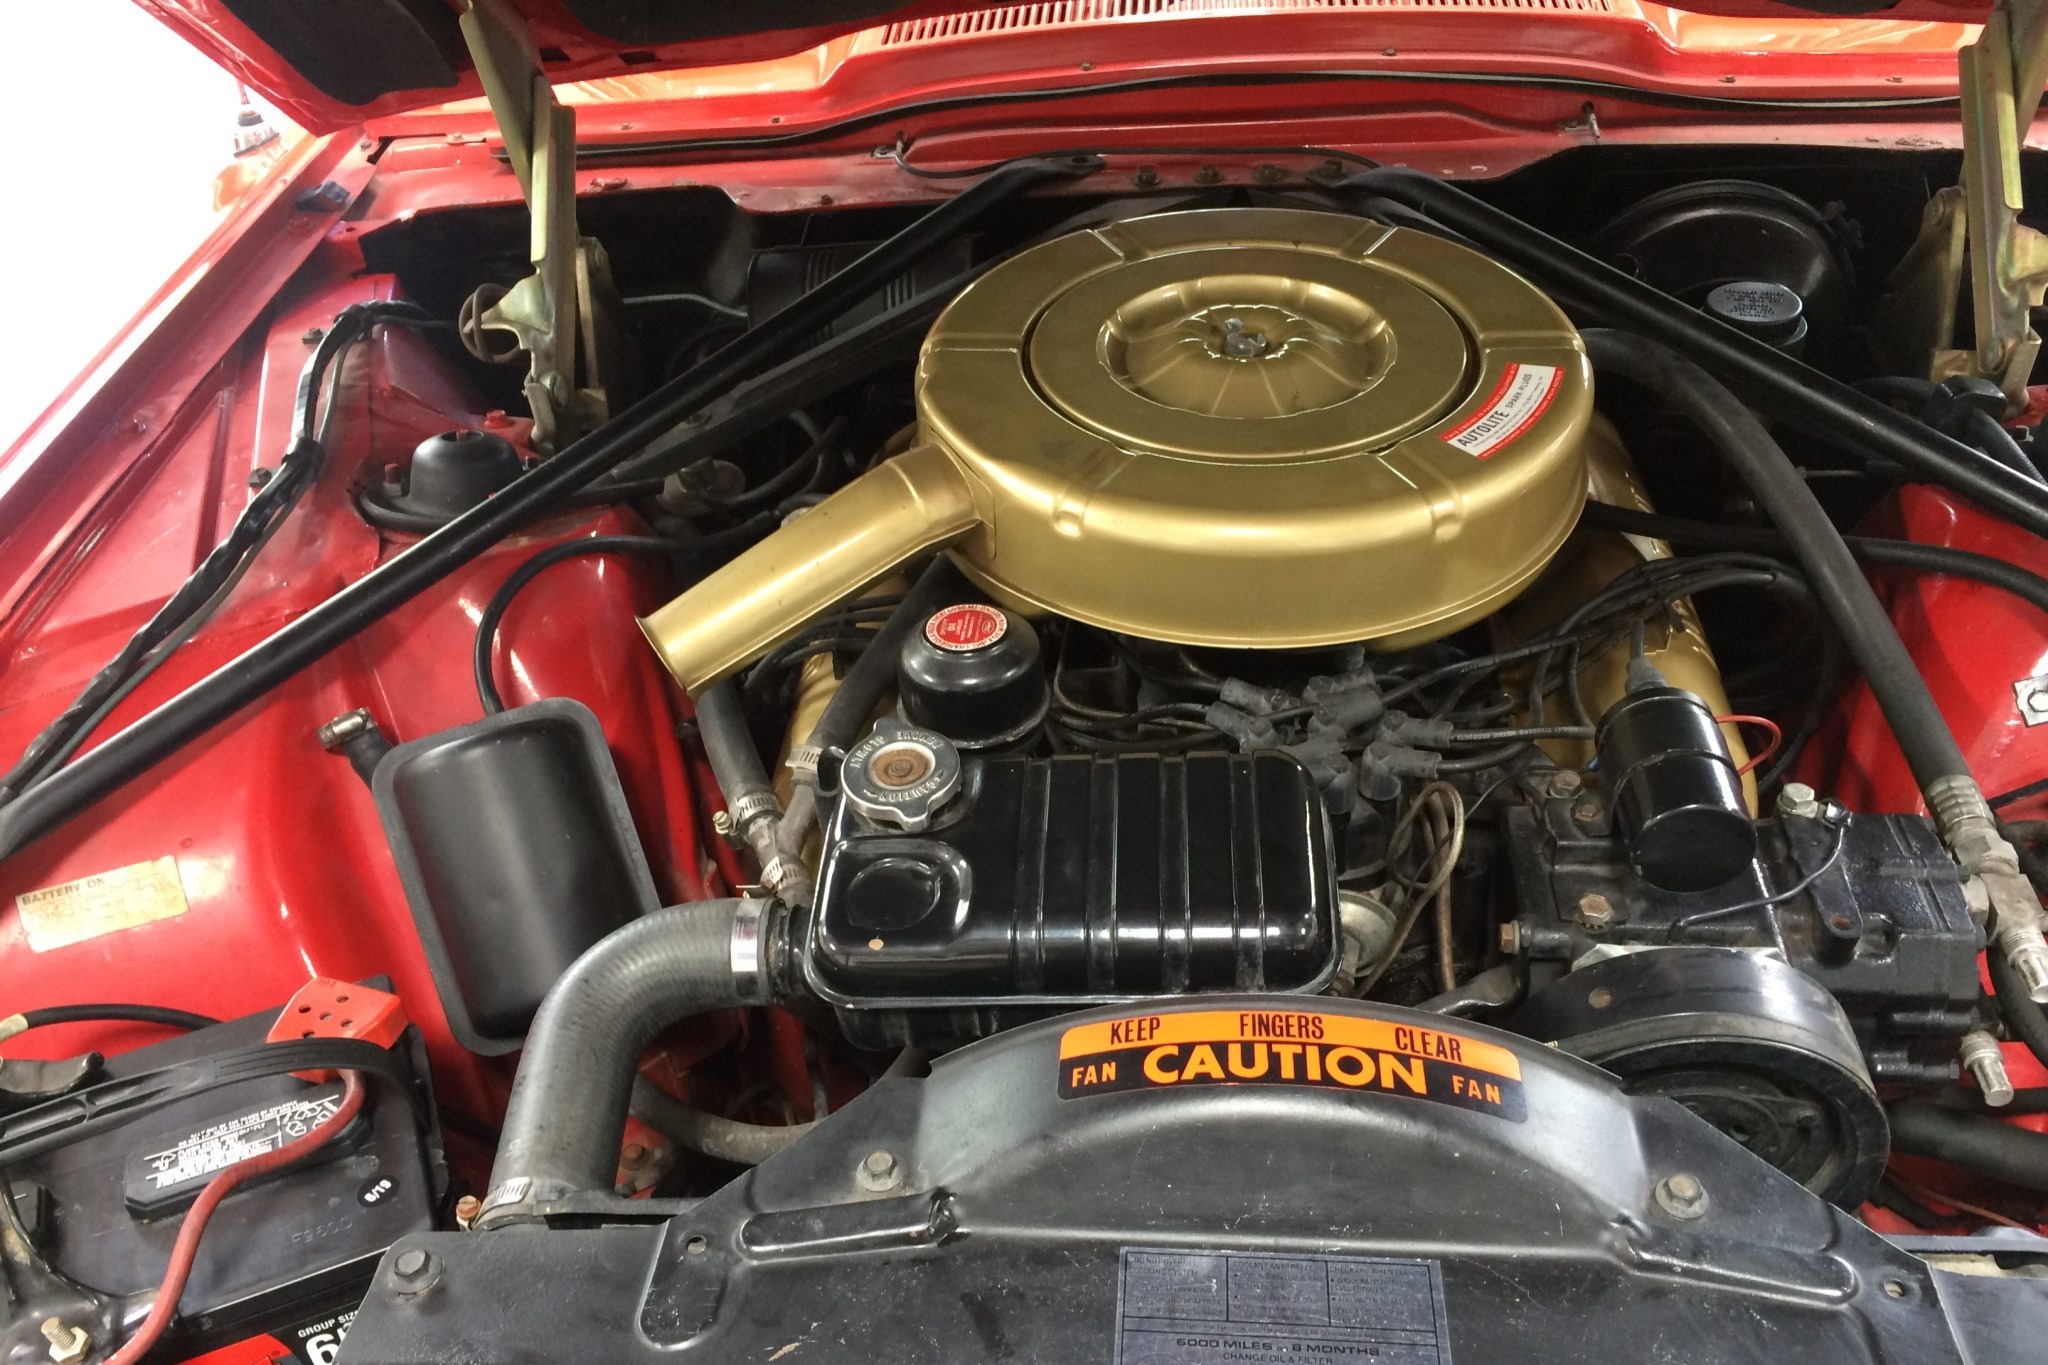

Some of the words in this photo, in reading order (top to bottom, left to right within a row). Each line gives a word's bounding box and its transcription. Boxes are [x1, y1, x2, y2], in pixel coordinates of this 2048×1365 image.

[1457, 410, 1510, 447] AUTOLITE
[1505, 391, 1522, 409] SPARK
[1519, 373, 1533, 391] PLUGS
[22, 883, 81, 906] BATTERY
[87, 877, 106, 889] OK
[1110, 1017, 1161, 1044] KEEP
[1239, 1013, 1324, 1040] FINGERS
[1394, 1027, 1462, 1063] CLEAR
[1071, 1061, 1117, 1088] FAN
[1143, 1044, 1428, 1095] CAUTION
[1452, 1076, 1501, 1105] FAN
[297, 1318, 336, 1338] GROUP
[1223, 1340, 1273, 1351] MILES
[1306, 1345, 1380, 1356] MONTHS
[1223, 1352, 1266, 1363] CHANGE
[1269, 1354, 1285, 1363] OIL
[1298, 1356, 1333, 1365] FILTER
